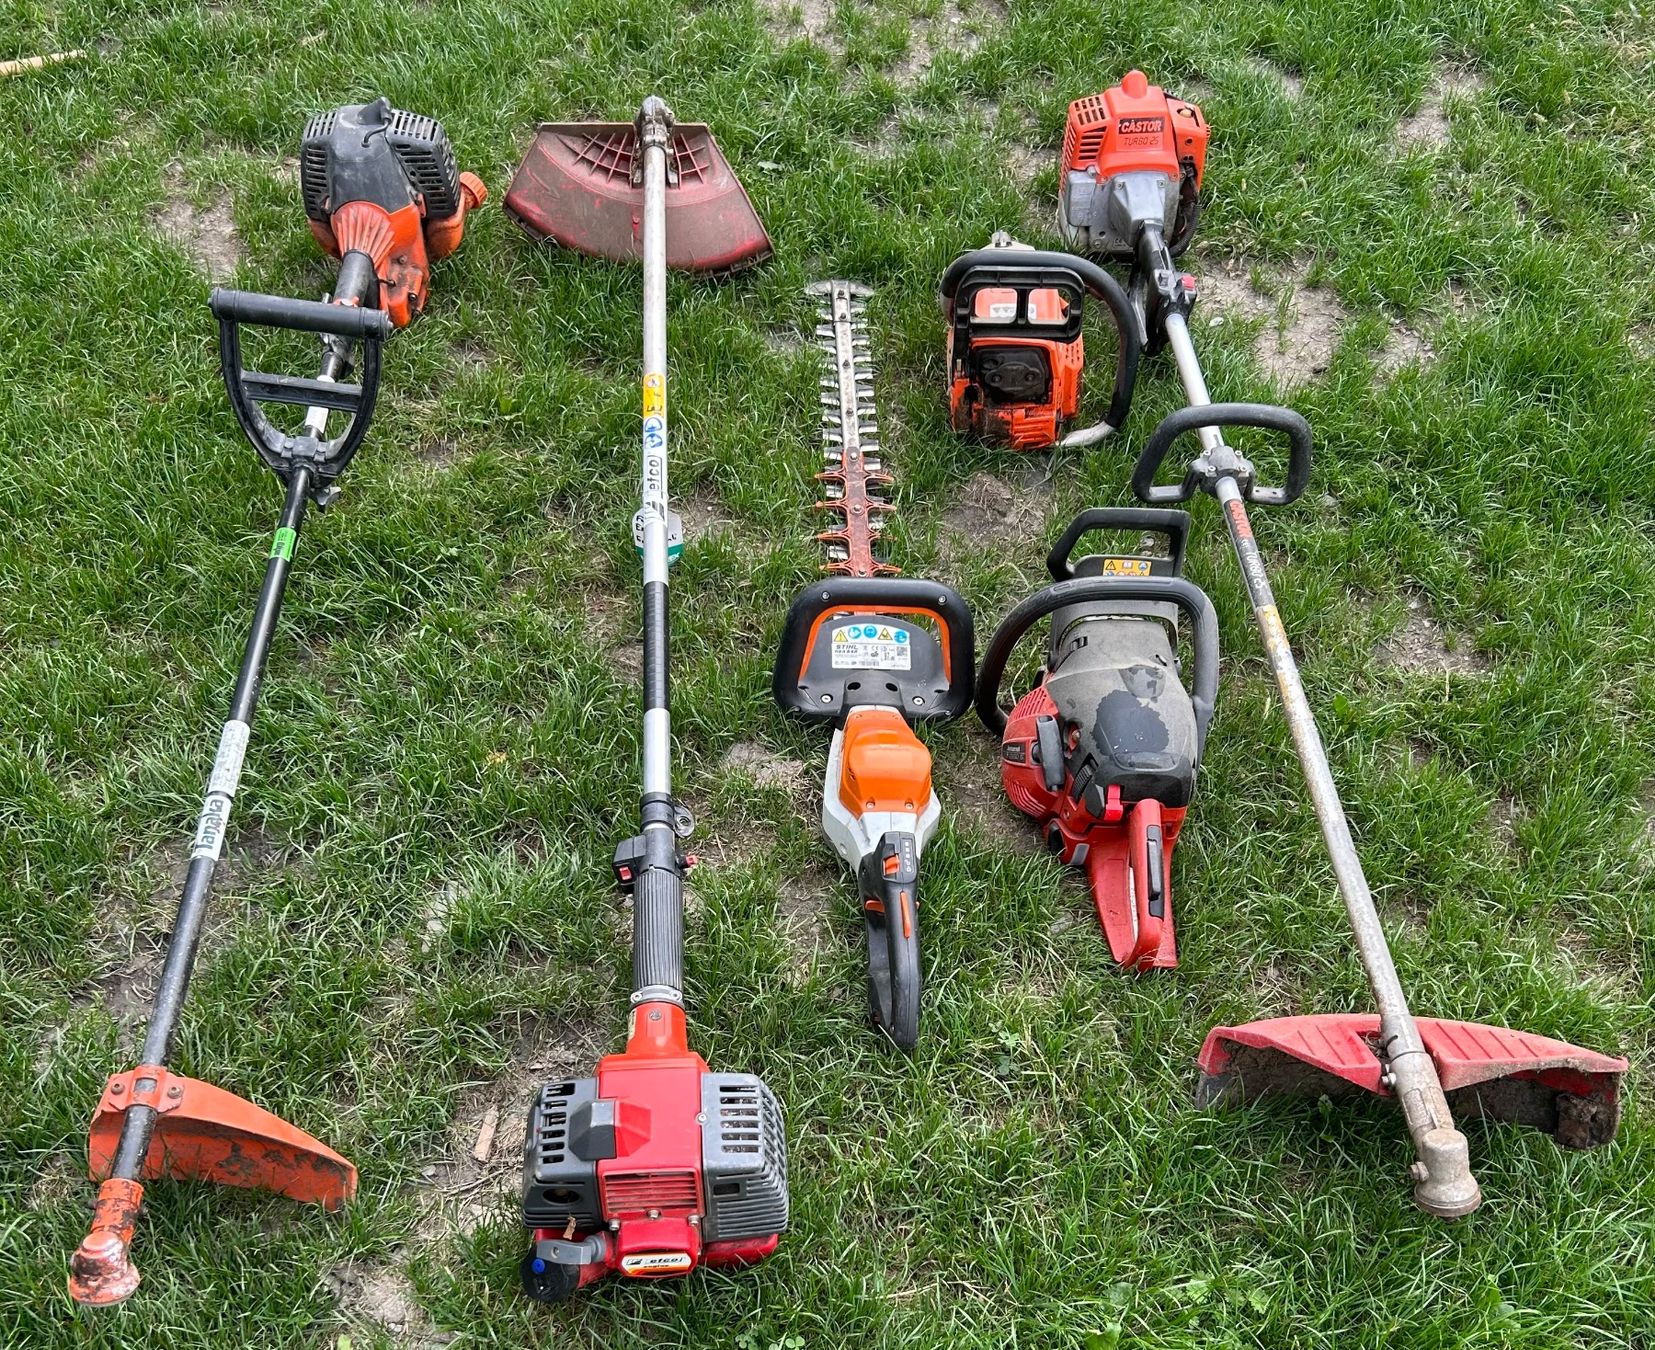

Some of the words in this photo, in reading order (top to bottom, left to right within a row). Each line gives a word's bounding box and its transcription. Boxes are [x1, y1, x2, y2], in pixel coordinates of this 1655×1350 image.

[1124, 136, 1149, 146] TURBO
[646, 458, 660, 492] efco
[1229, 499, 1253, 538] CASTOR
[1246, 552, 1263, 578] TURBO
[195, 799, 224, 850] Tanaka
